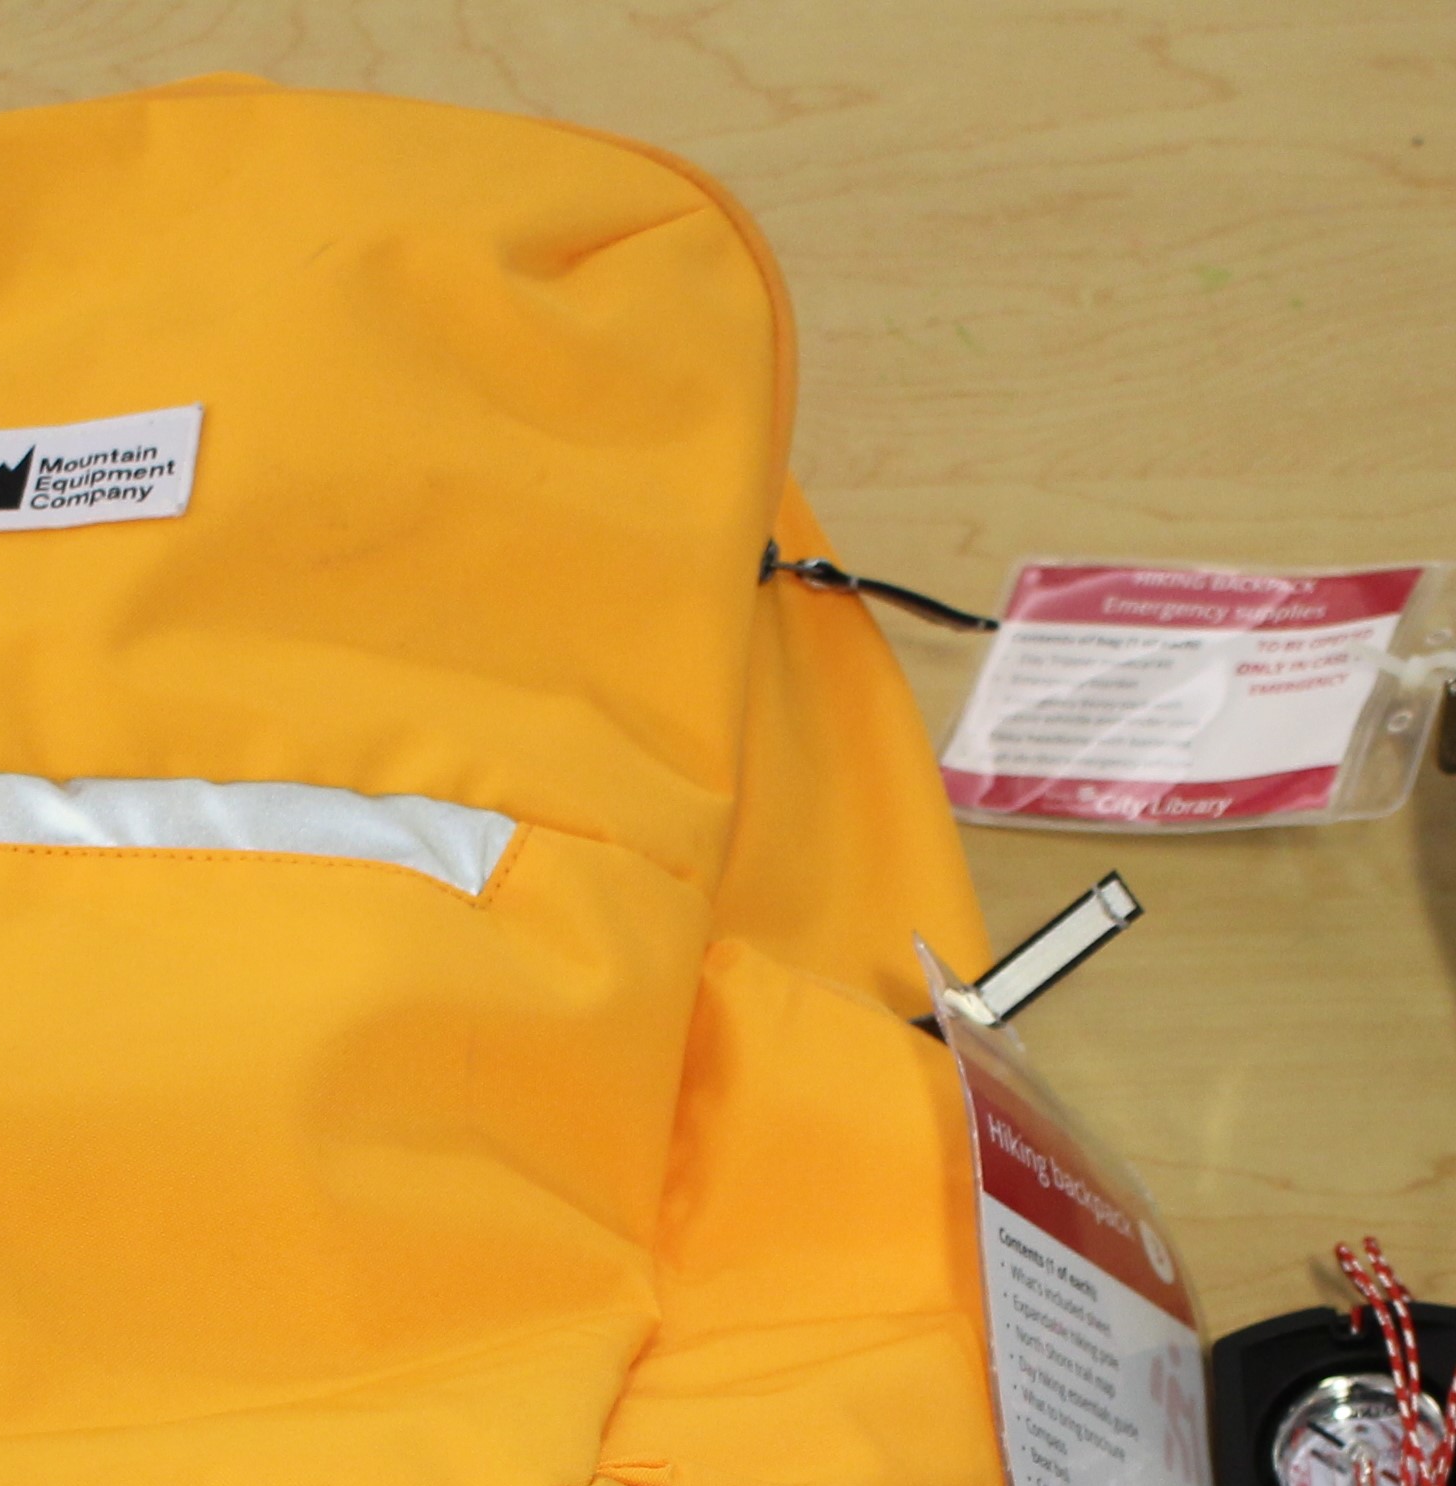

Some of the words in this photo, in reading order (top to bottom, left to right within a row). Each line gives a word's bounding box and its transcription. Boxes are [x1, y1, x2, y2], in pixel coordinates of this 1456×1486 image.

[39, 444, 158, 475] Mountain
[34, 459, 176, 495] Equipment
[30, 483, 154, 511] Company
[1102, 596, 1230, 624] Emergency
[1234, 604, 1329, 623] supplies
[1094, 796, 1150, 821] City
[1150, 796, 1233, 819] Library
[988, 1112, 1051, 1189] Hiking
[999, 1226, 1044, 1268] Contents
